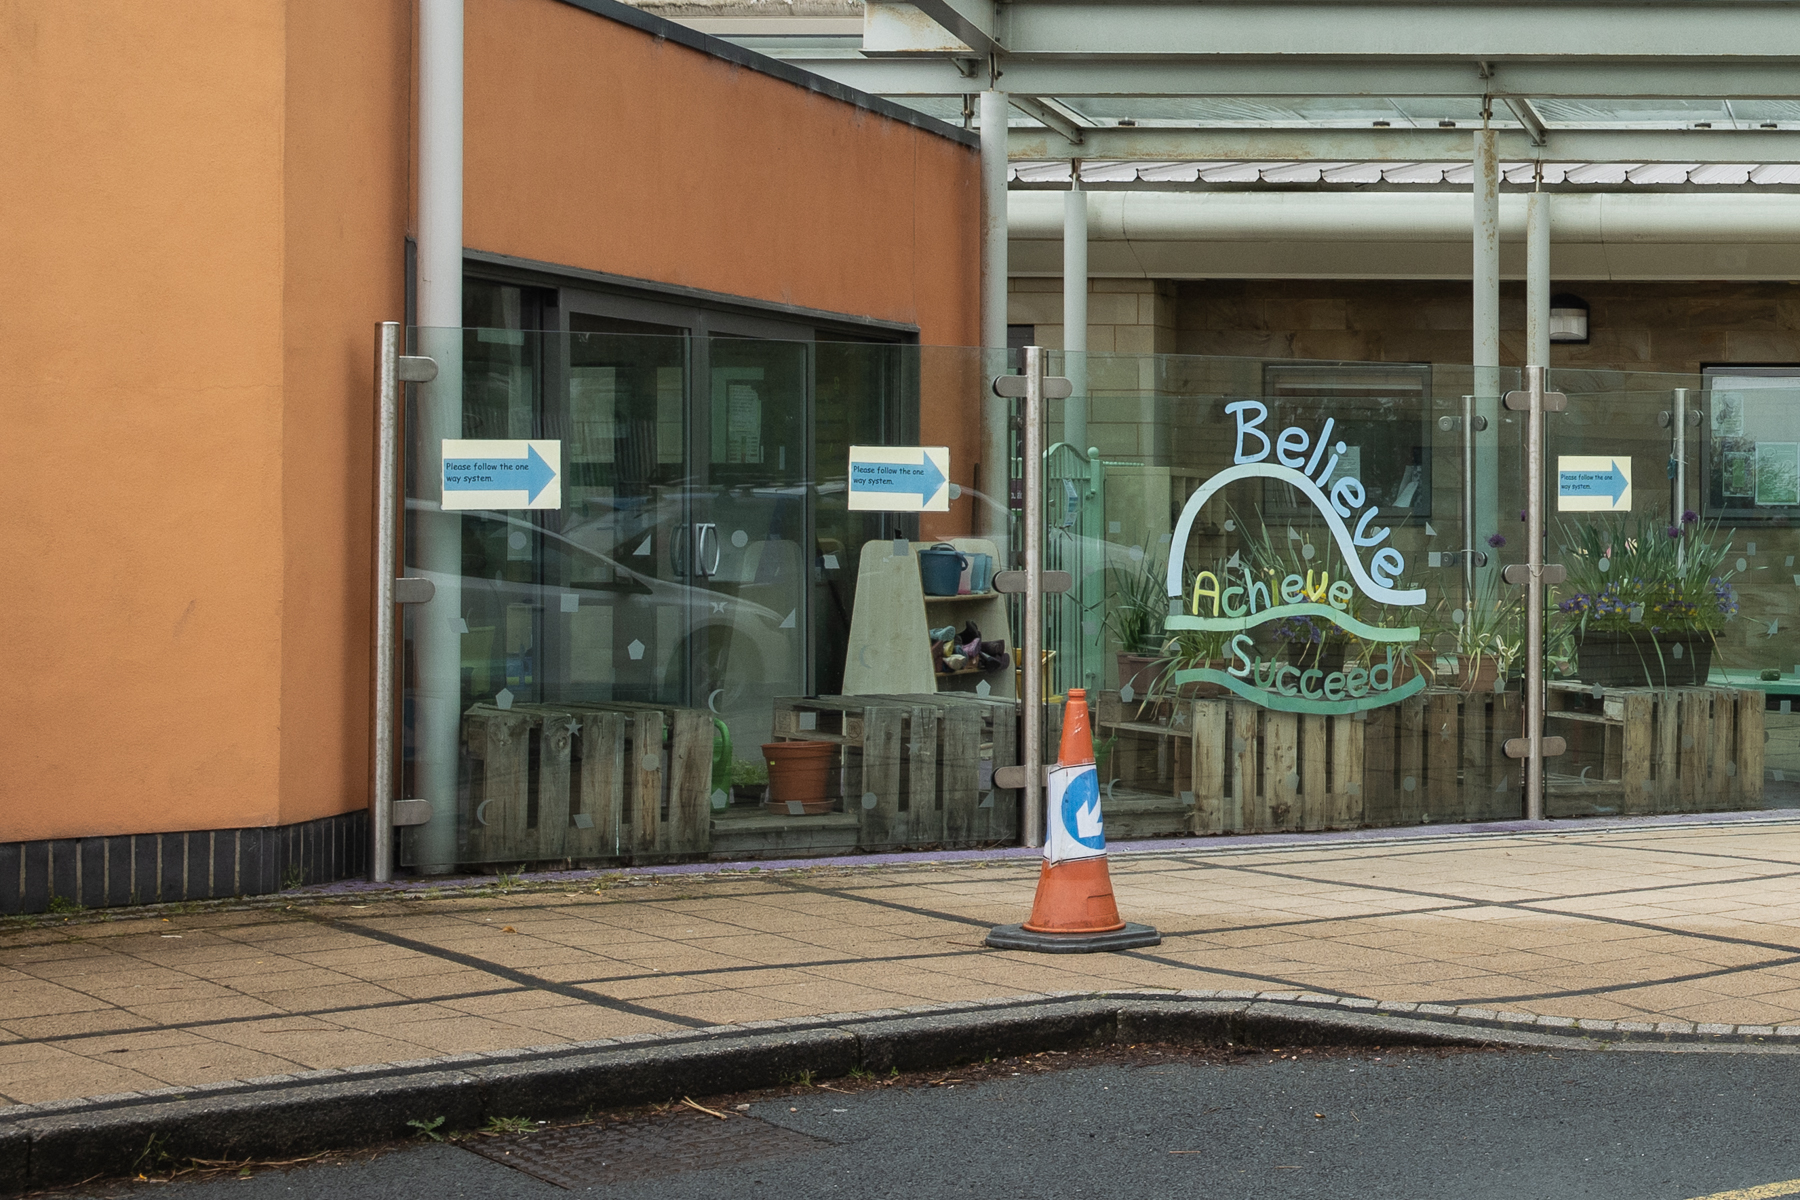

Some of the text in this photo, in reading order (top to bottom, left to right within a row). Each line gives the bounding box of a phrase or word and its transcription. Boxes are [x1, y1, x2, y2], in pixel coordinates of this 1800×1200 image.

[446, 462, 472, 471] Please
[473, 462, 498, 471] follow
[499, 462, 514, 471] the
[853, 465, 875, 474] Please
[877, 466, 898, 474] follow
[446, 475, 494, 484] way system.
[1561, 473, 1577, 481] Please
[853, 478, 894, 486] way system.
[1224, 400, 1405, 589] Believe
[1192, 569, 1353, 618] Achieve
[1227, 633, 1395, 701] Succeed
